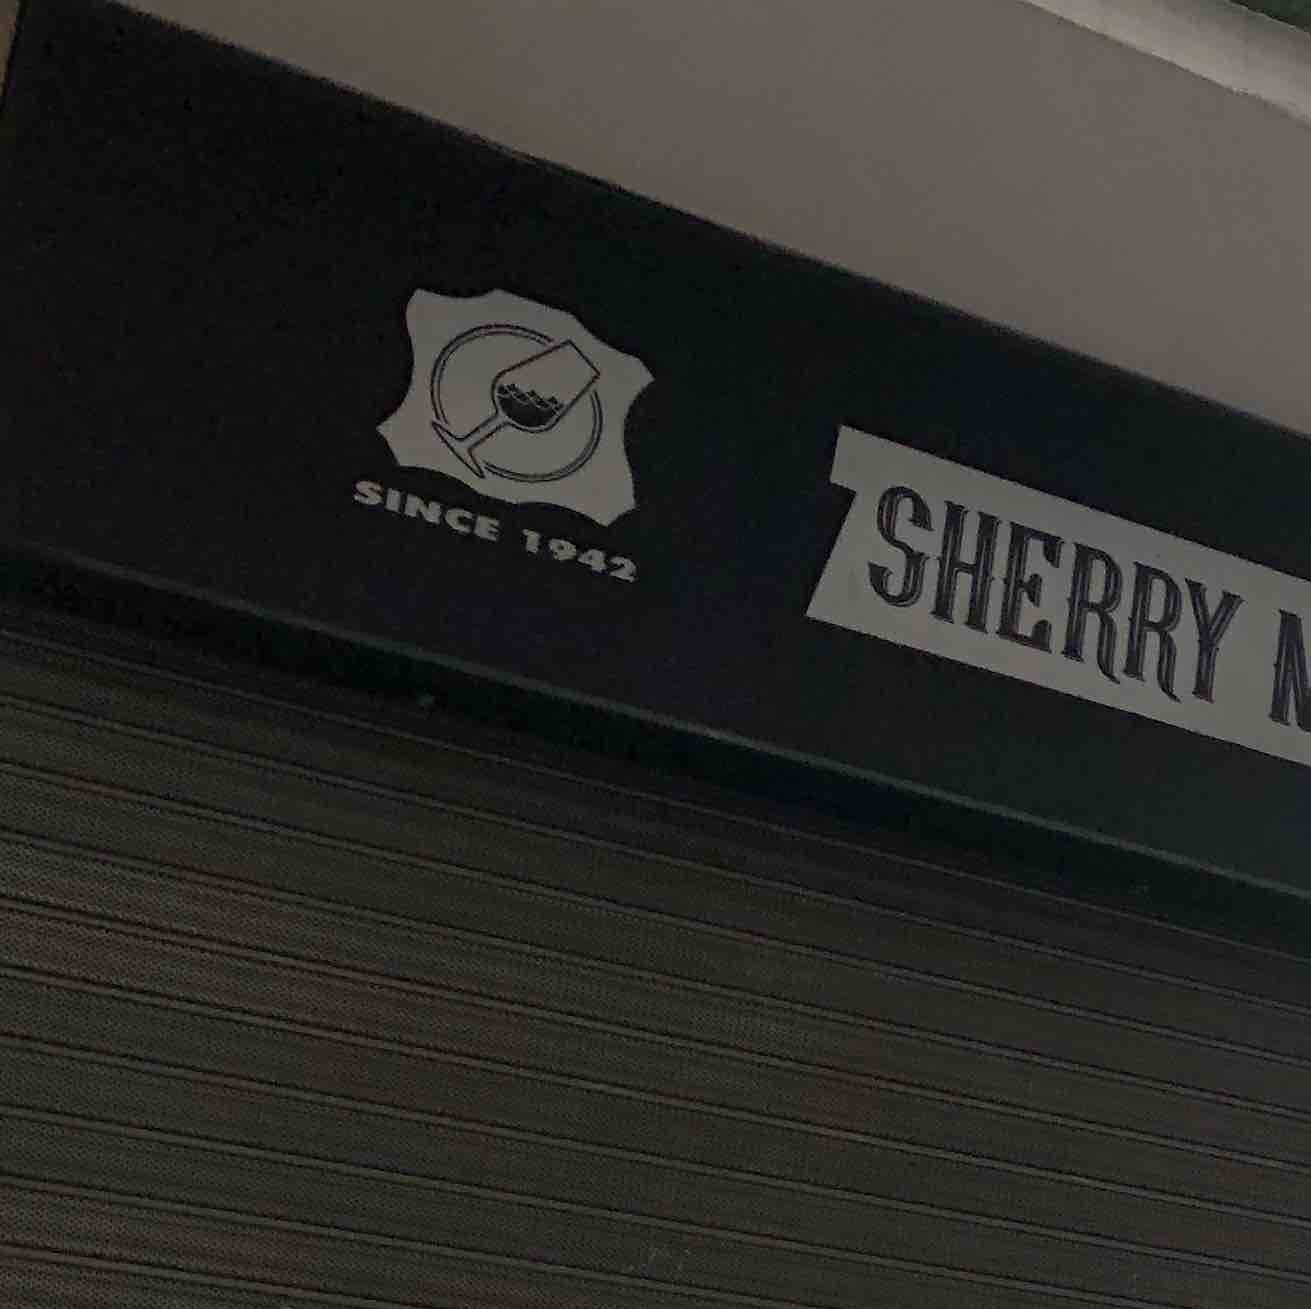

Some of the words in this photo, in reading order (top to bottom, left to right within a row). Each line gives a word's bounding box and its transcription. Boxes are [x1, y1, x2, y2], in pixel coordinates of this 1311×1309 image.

[353, 479, 500, 542] SINCE
[521, 527, 638, 583] 1942
[868, 485, 1245, 703] SHERRY
